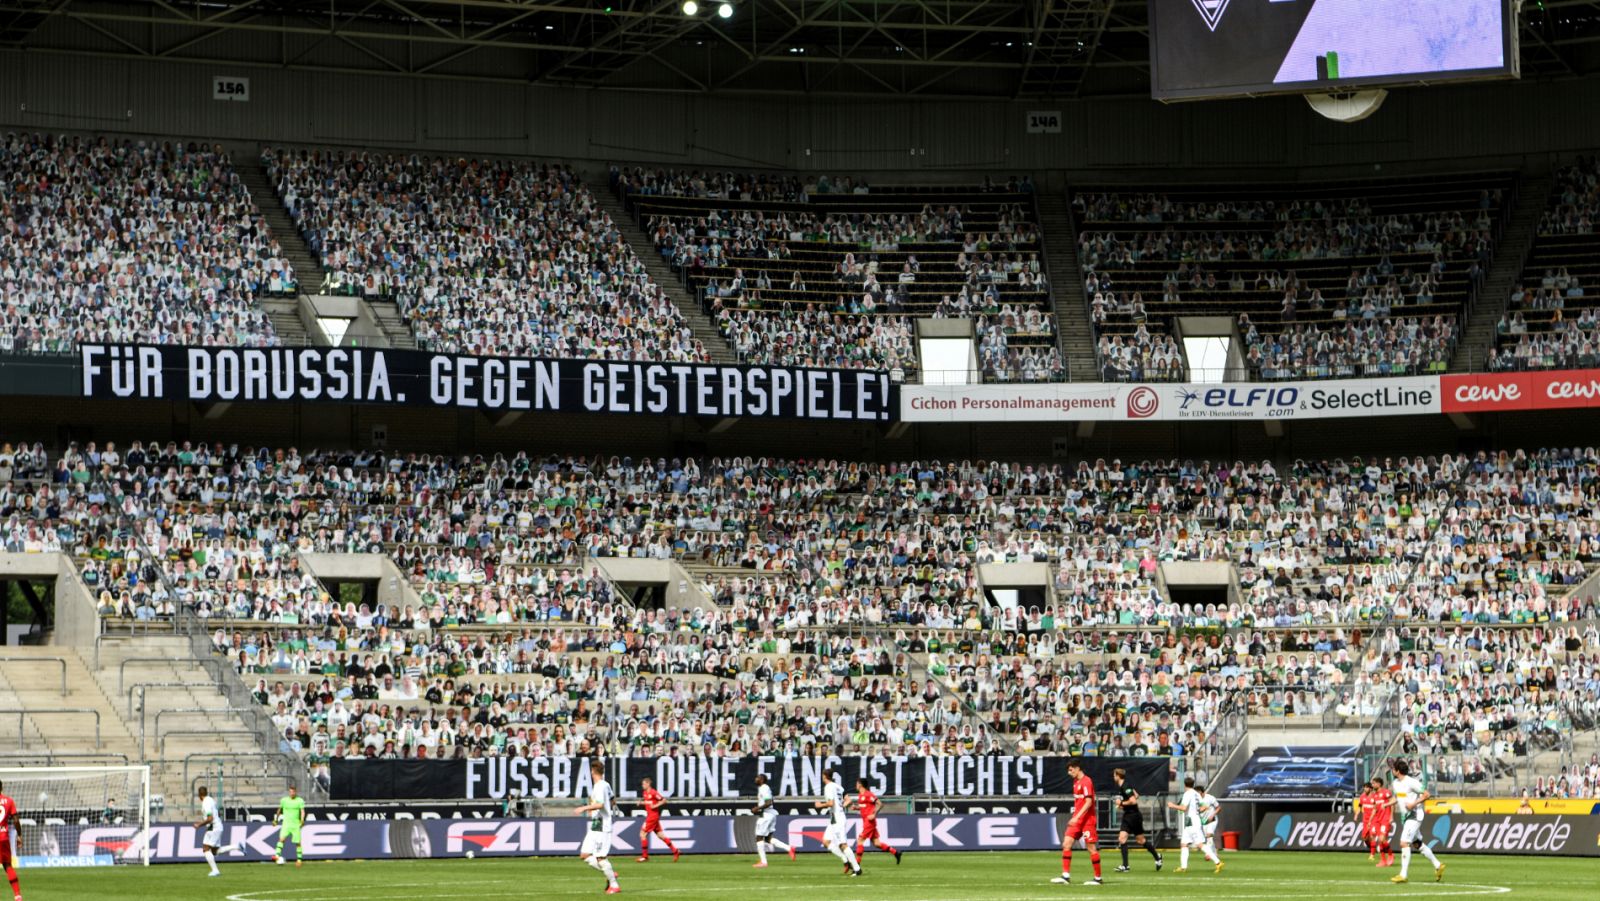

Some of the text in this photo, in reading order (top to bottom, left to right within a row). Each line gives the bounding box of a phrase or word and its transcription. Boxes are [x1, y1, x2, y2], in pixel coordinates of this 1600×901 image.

[217, 82, 245, 94] 15A
[1031, 116, 1058, 127] 14A
[82, 345, 889, 420] FÜR BORUSSIA. GEGEN GEISTERSPIELE!
[1547, 380, 1600, 399] cew
[1300, 387, 1432, 409] & SelectLine
[1455, 384, 1521, 403] cewe
[911, 396, 1116, 412] Cichon Personalmanagement
[1265, 408, 1294, 417] .com
[466, 756, 637, 799] FUSSBAL
[656, 755, 740, 798] OHNE
[925, 755, 1043, 796] NICHTS!
[357, 812, 386, 820] BRAX
[705, 808, 732, 816] BRAX
[1447, 815, 1570, 851] reuter.de
